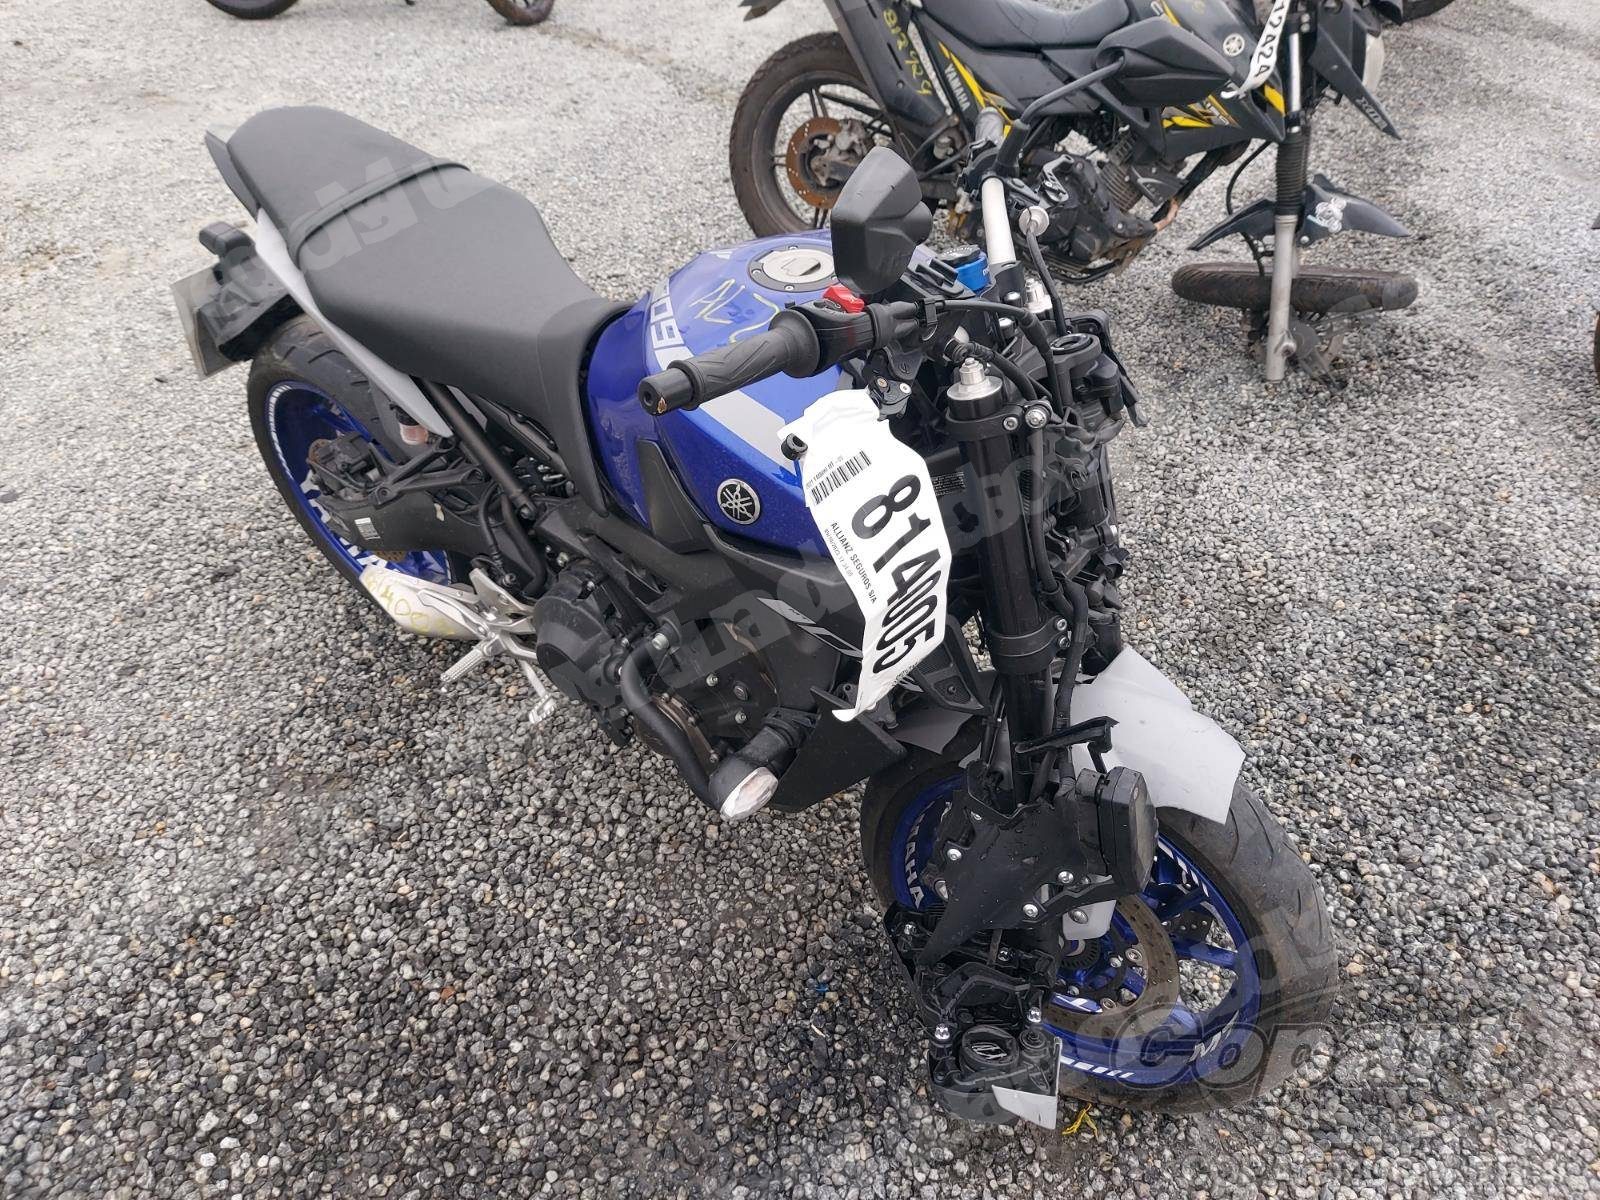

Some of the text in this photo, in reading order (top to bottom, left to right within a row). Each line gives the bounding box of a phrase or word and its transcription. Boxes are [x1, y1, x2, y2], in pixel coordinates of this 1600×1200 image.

[944, 62, 970, 112] YAMAHA
[831, 522, 854, 555] ALLIANZ
[850, 553, 872, 590] SEGUROS
[851, 474, 942, 674] 814005
